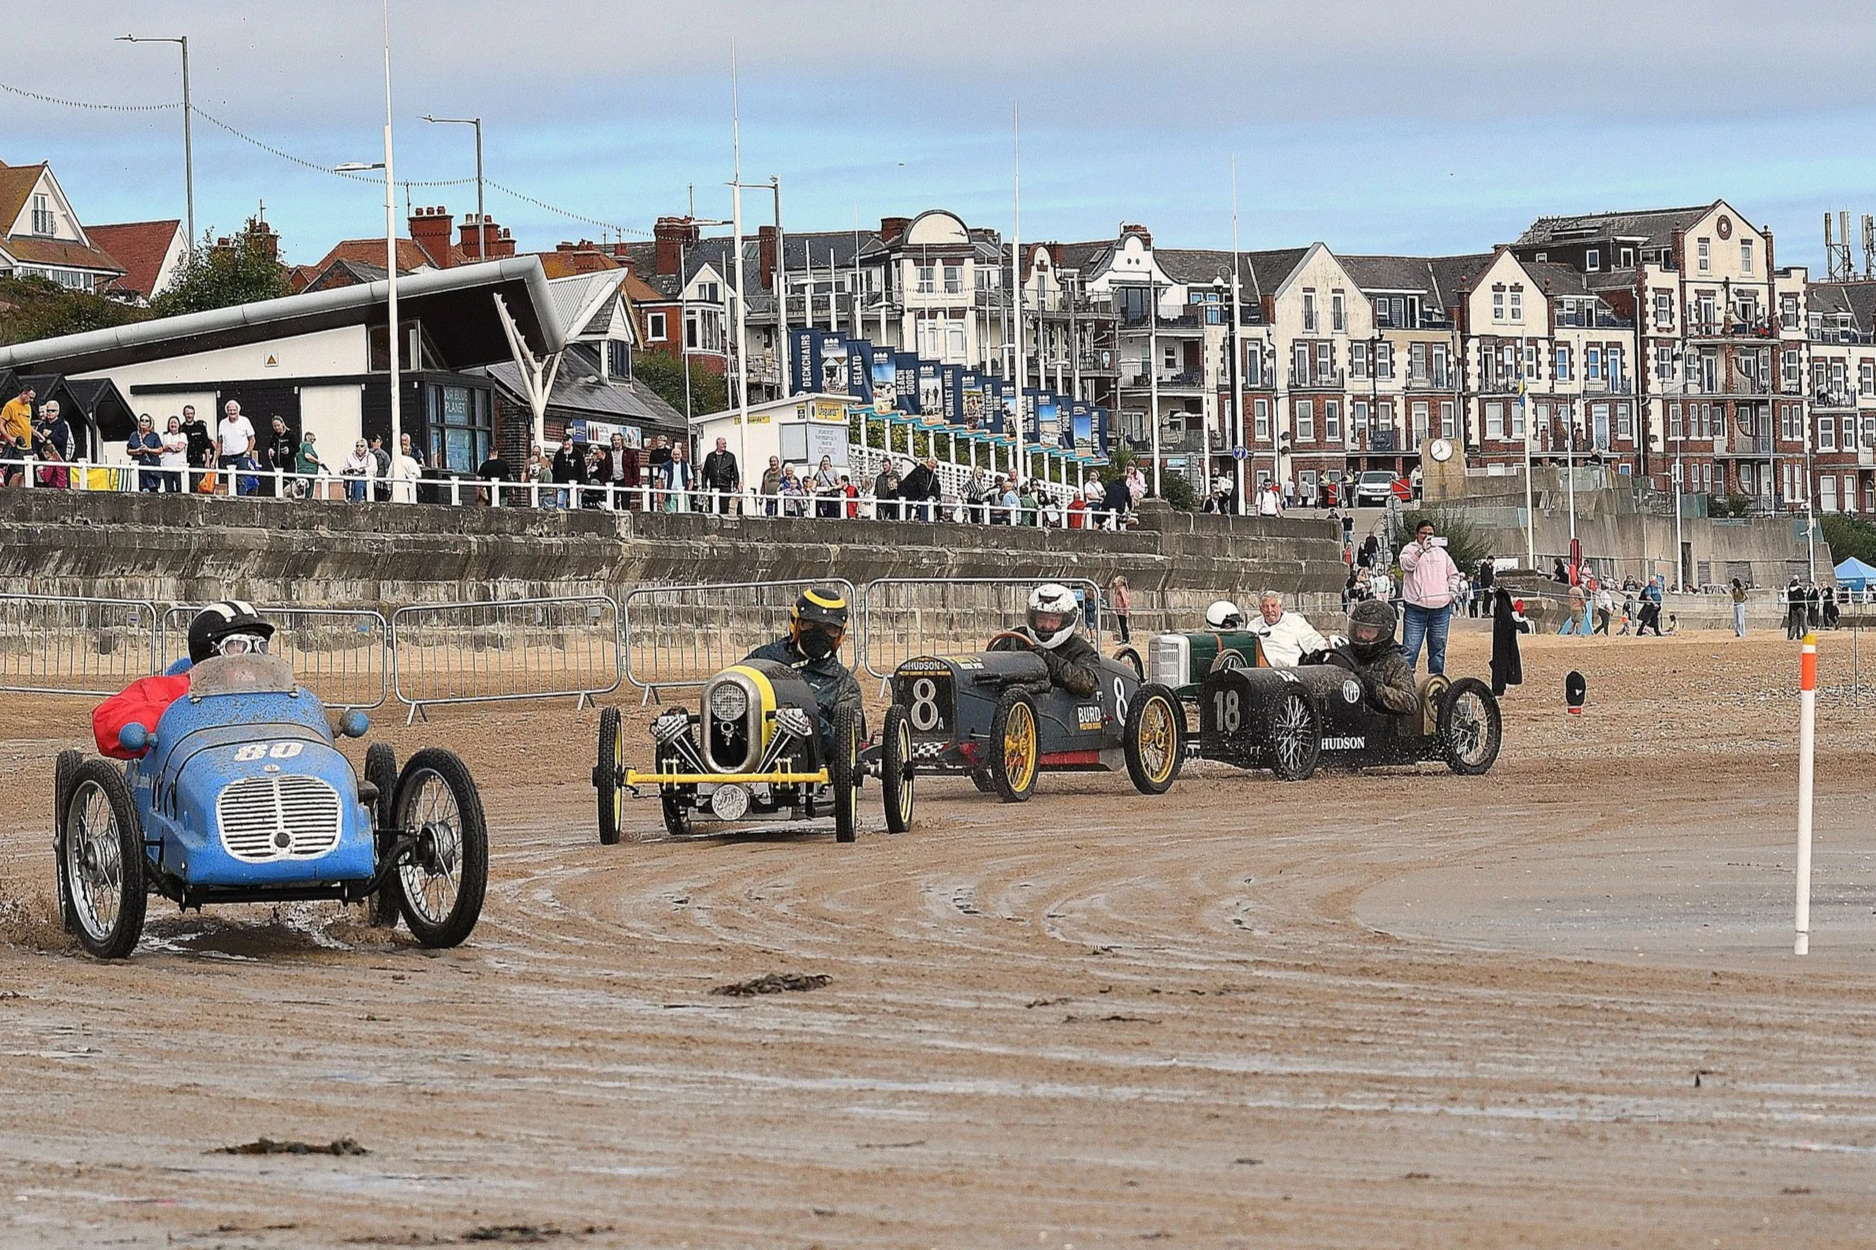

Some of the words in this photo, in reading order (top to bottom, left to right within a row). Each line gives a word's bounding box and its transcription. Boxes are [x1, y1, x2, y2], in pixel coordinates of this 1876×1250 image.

[800, 334, 812, 388] DECKCHAIRS
[852, 355, 863, 386] GELATO
[896, 369, 906, 395] BEACH
[906, 369, 915, 395] GOODS
[944, 369, 954, 387] HIRE
[445, 401, 465, 414] PLANET
[945, 389, 955, 417] CHALET
[984, 383, 994, 424] WHEELCHAIR
[1061, 410, 1070, 432] POOLS
[1091, 411, 1099, 432] TRAIN
[1092, 433, 1100, 451] LAND
[908, 661, 940, 670] HUDSON
[911, 677, 939, 731] 8
[937, 716, 944, 730] A
[1113, 676, 1128, 727] 8
[1213, 689, 1240, 732] 18
[1077, 706, 1101, 723] BURD
[233, 742, 304, 762] 80
[1321, 736, 1366, 750] HUDSON
